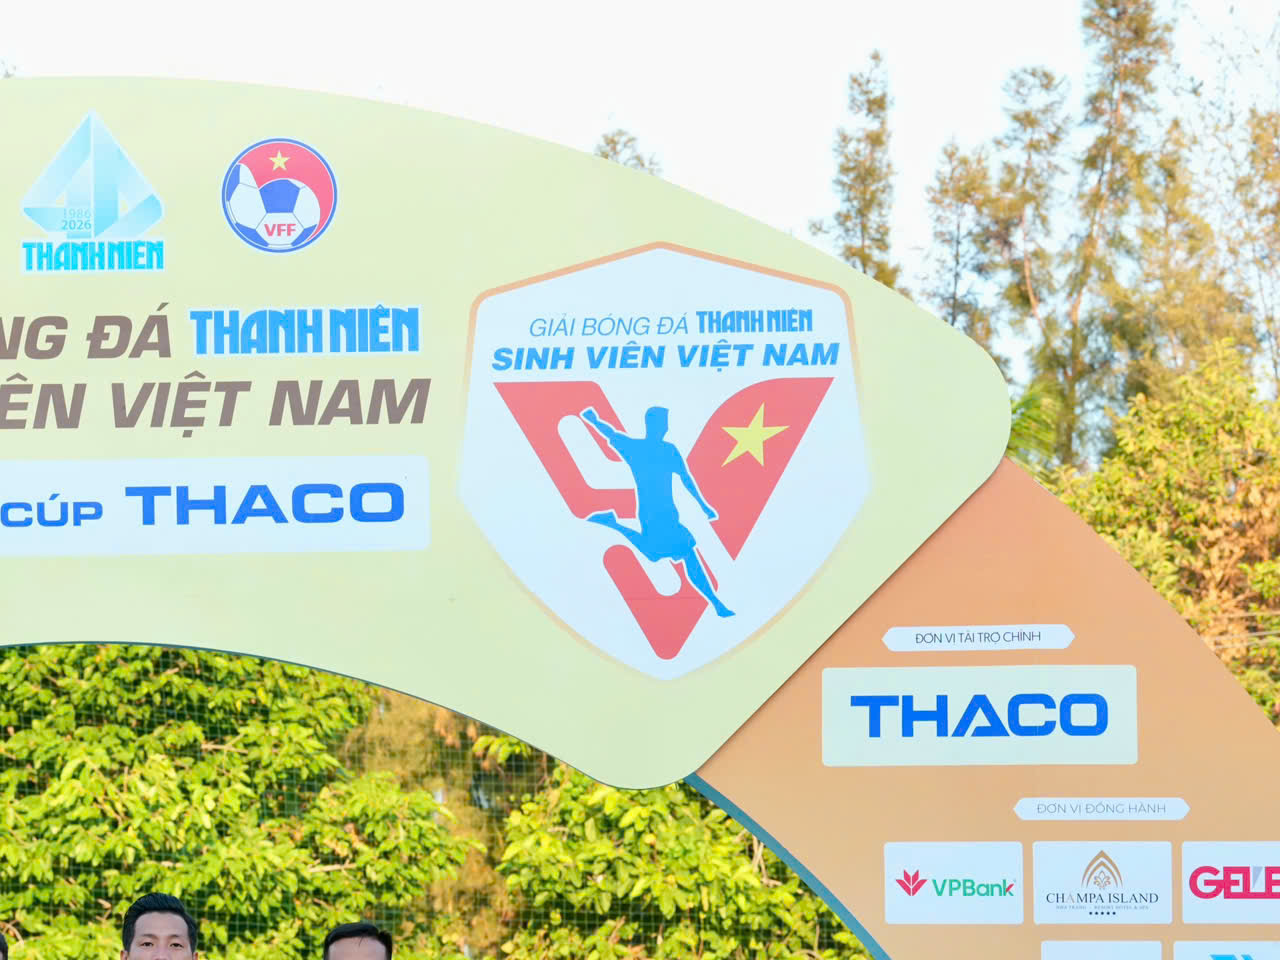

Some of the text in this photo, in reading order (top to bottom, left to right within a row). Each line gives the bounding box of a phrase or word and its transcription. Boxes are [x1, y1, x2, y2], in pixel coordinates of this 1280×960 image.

[61, 220, 91, 230] 2026
[264, 223, 296, 237] VFF
[86, 302, 172, 359] ĐÁ
[189, 308, 324, 354] THANH
[330, 304, 419, 353] NIÊN
[529, 307, 812, 337] GIẢI BÓNG ĐÁ THANH NIÊN
[491, 339, 840, 373] SINH VIÊN VIỆT NAM
[110, 370, 251, 437] VIỆT
[268, 377, 431, 426] NAM
[0, 481, 406, 528] CÚP THACO
[915, 629, 1041, 644] ĐƠN VỊ TÀI TRỢ CHÍNH
[850, 692, 1109, 738] THACO
[1037, 803, 1067, 814] ĐƠN
[1128, 801, 1166, 813] HÀNH
[931, 879, 1015, 897] VPBank
[1046, 892, 1159, 904] CHAMPA ISLAND
